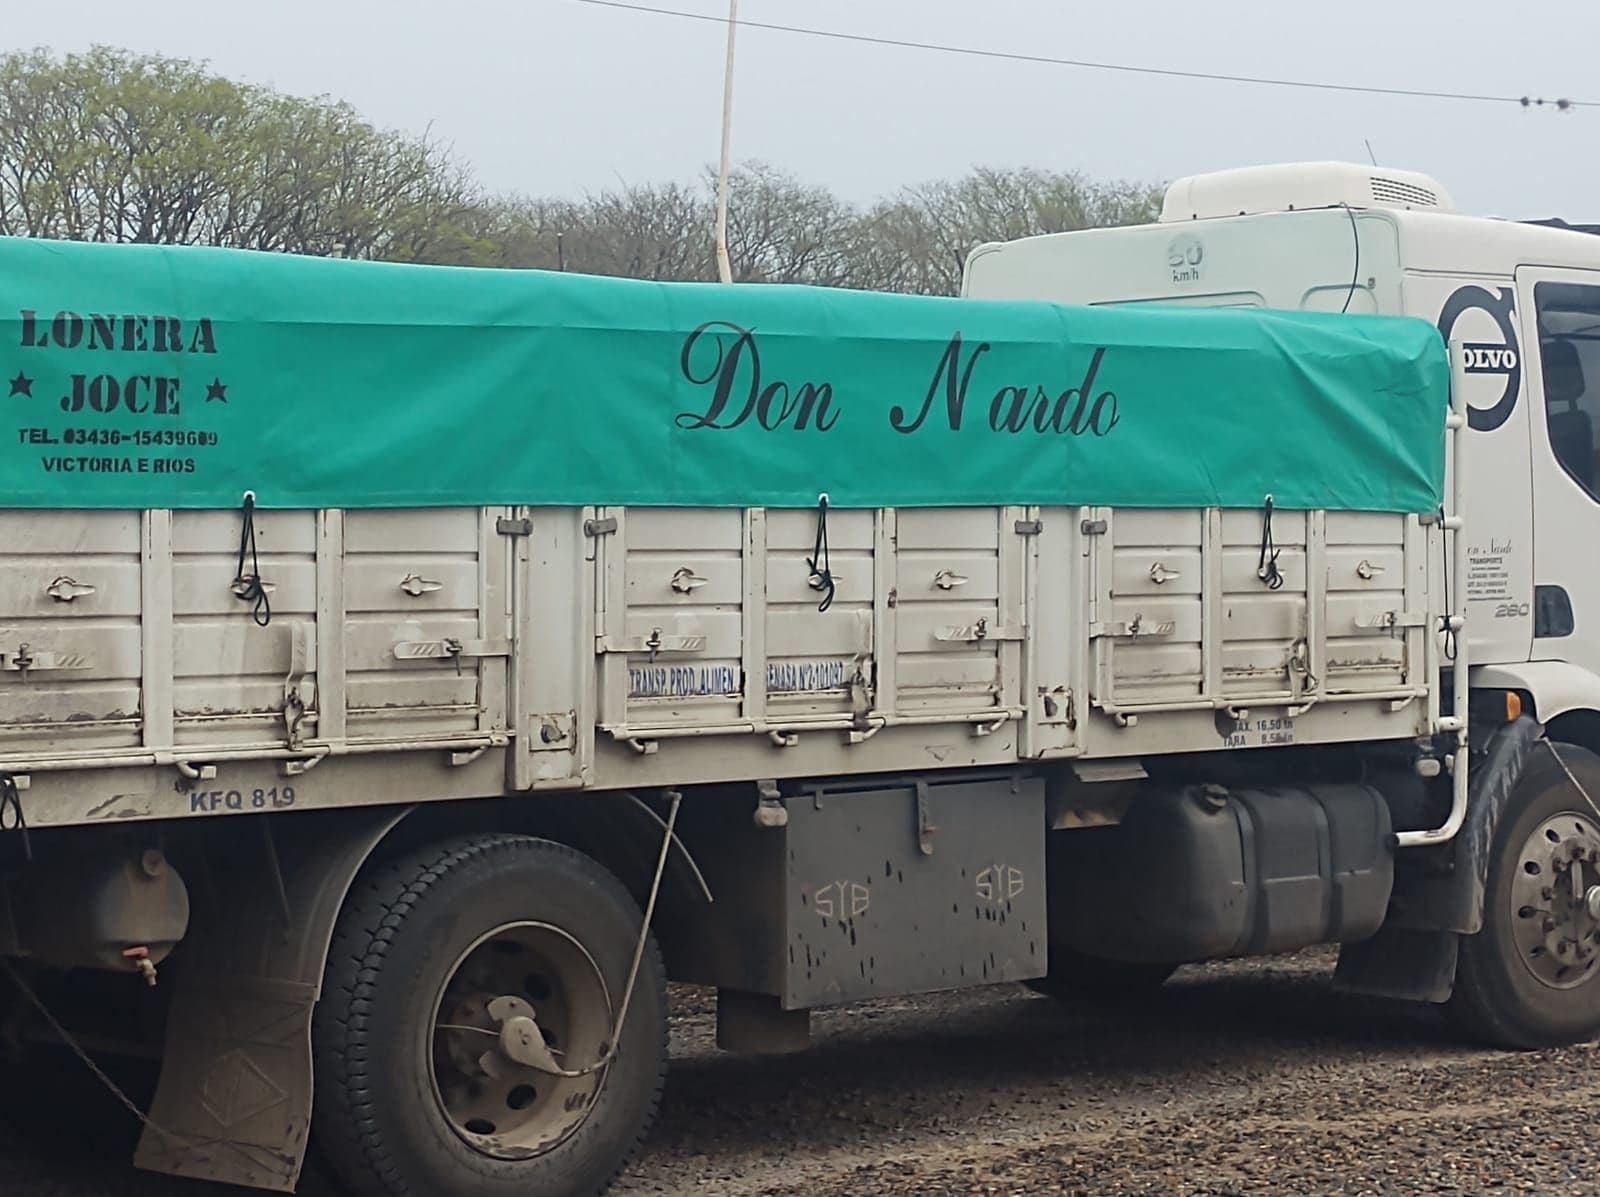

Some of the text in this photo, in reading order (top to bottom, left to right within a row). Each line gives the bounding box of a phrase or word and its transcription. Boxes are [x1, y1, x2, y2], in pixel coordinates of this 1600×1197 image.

[20, 309, 218, 354] LONERA
[1463, 348, 1517, 368] OLVO
[675, 320, 841, 432] Don
[60, 374, 180, 415] JOCE
[18, 428, 59, 444] TEL.
[41, 457, 196, 474] VICTORIA E RIOS
[190, 787, 295, 812] KFQ 819
